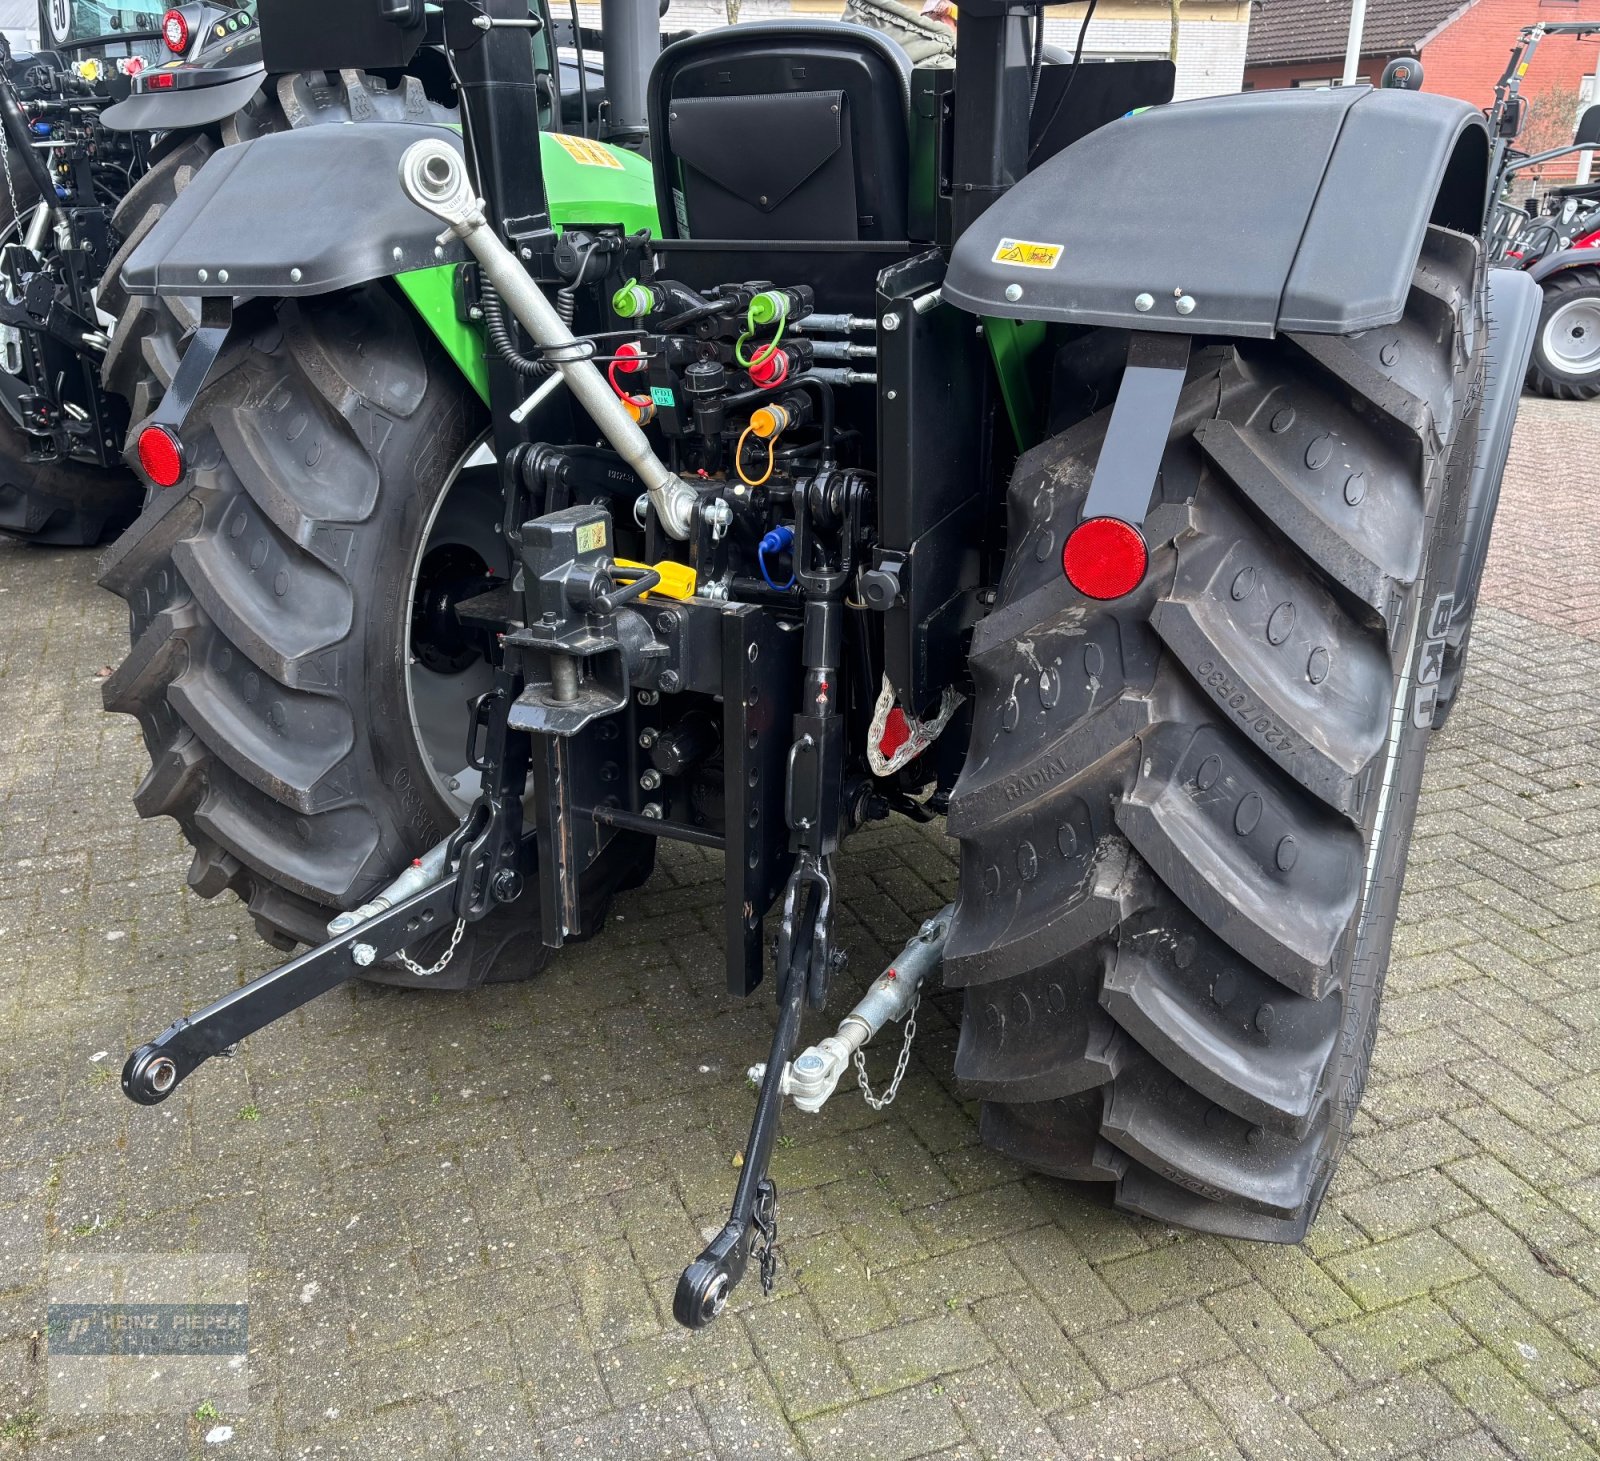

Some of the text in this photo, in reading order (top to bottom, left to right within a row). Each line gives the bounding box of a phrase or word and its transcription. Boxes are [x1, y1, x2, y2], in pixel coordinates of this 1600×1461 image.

[53, 0, 66, 31] 50
[1414, 595, 1456, 728] BKT
[1197, 661, 1294, 752] 420/70R30
[1003, 756, 1069, 801] RADIAL
